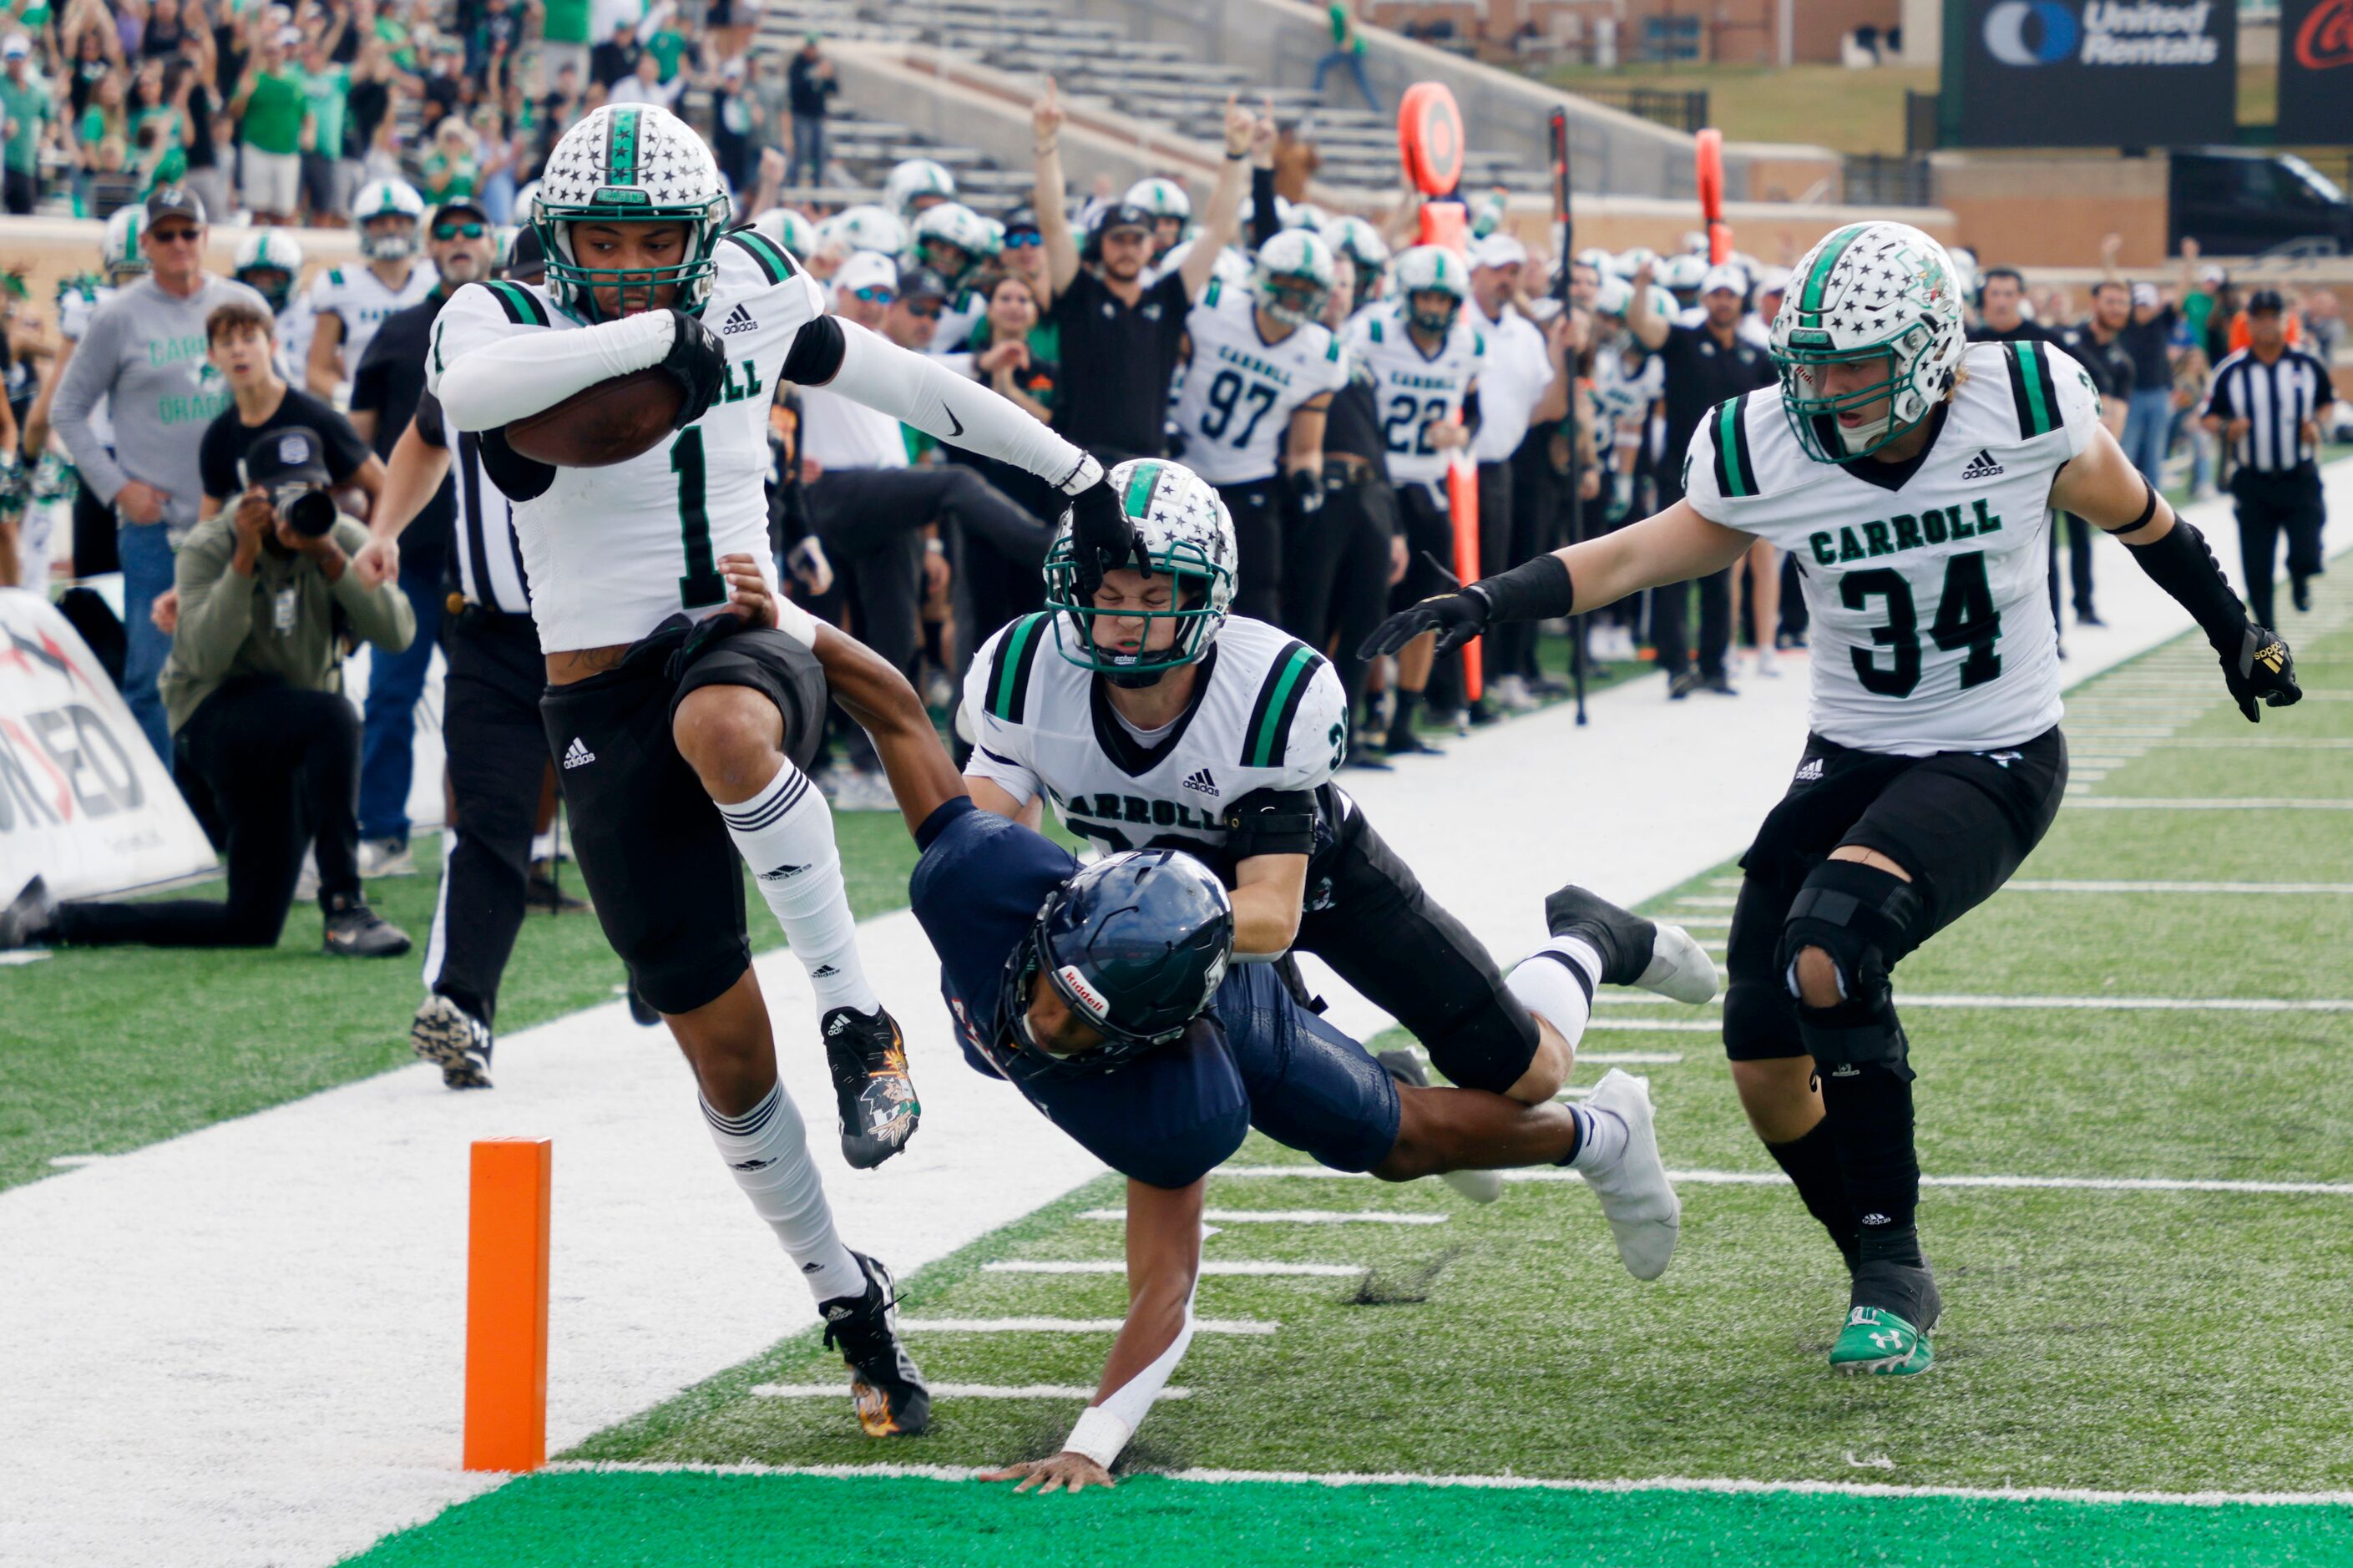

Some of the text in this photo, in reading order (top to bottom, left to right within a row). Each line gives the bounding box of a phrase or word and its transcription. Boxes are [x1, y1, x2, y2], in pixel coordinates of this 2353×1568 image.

[2083, 0, 2210, 33] United
[2081, 33, 2219, 65] Rentals
[723, 321, 758, 335] adidas
[709, 359, 762, 407] LL
[1201, 368, 1278, 448] 97
[1385, 394, 1448, 455] 22
[1962, 466, 2004, 480] adidas
[670, 425, 727, 609] 1
[1809, 498, 2002, 566] CARROLL
[1838, 550, 2002, 699] 34
[2254, 641, 2282, 660] adidas
[564, 752, 595, 769] adidas
[1045, 783, 1227, 832] ARROLL
[1183, 780, 1220, 797] adidas
[1066, 972, 1104, 1011] Riddell
